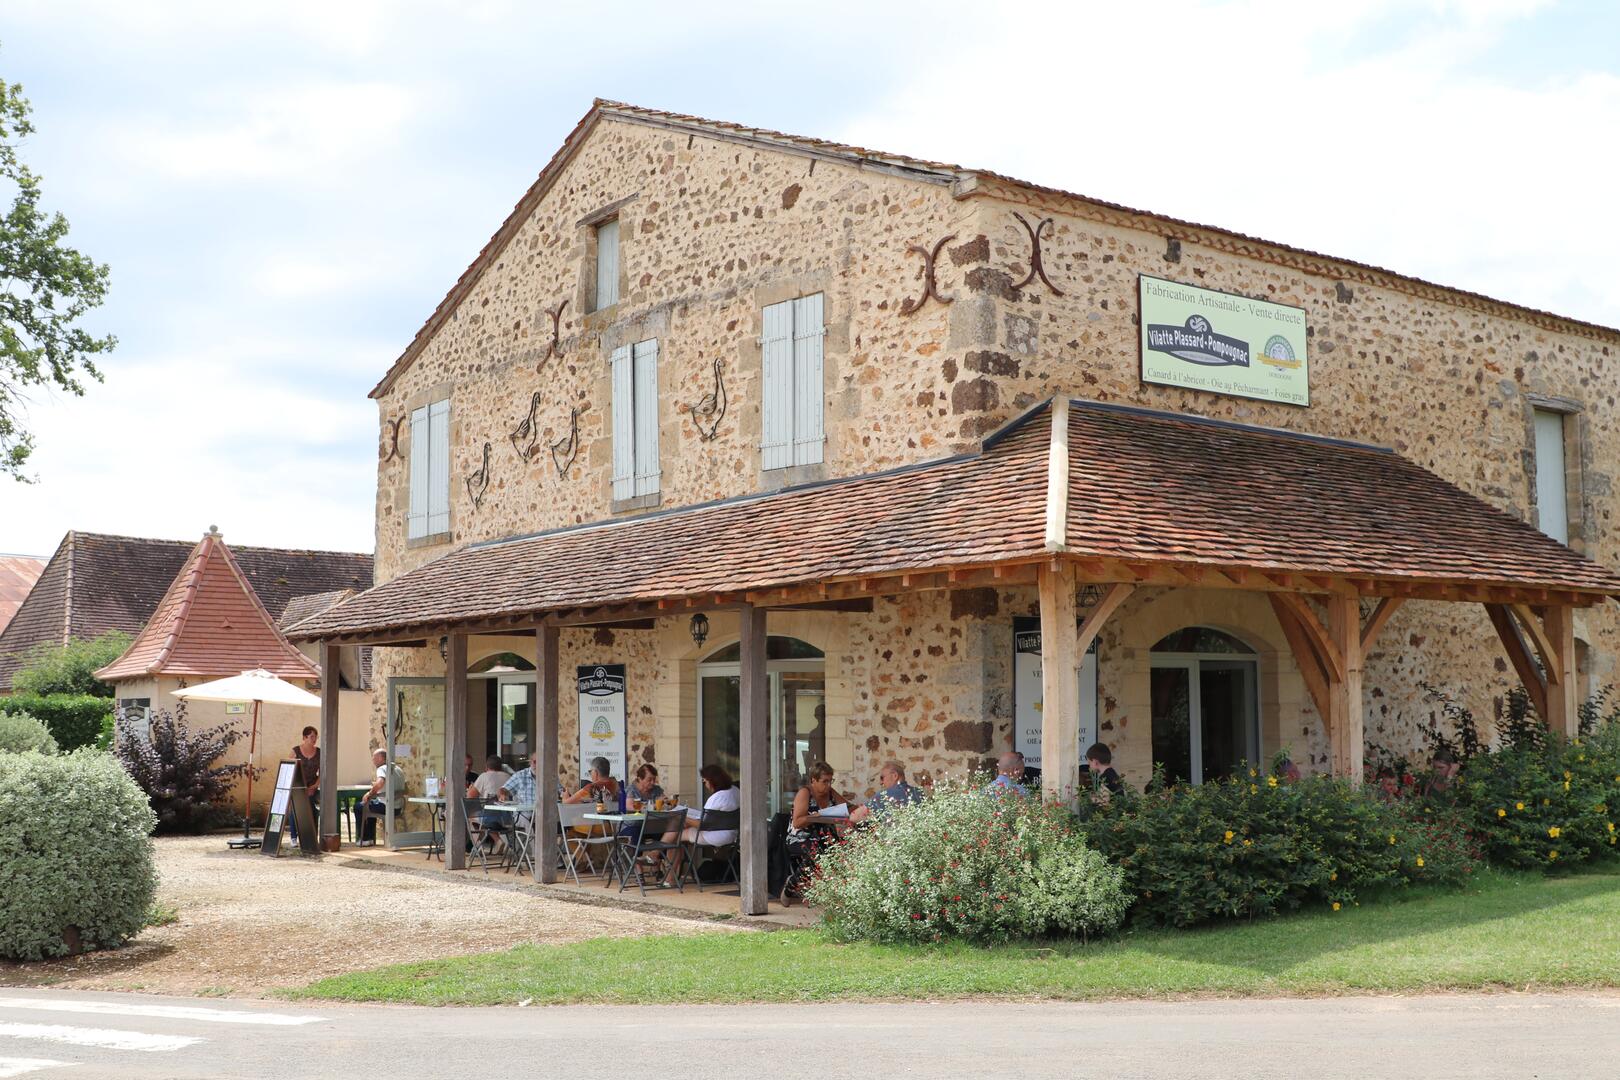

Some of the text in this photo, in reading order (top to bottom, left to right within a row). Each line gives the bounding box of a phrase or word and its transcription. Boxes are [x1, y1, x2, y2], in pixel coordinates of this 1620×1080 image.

[1146, 282, 1196, 304] Fabrication
[1197, 294, 1240, 313] Artisanale
[1248, 303, 1273, 319] Vente
[1274, 309, 1301, 325] directe
[1148, 329, 1173, 346] Vilatte
[1147, 367, 1172, 380] Canard
